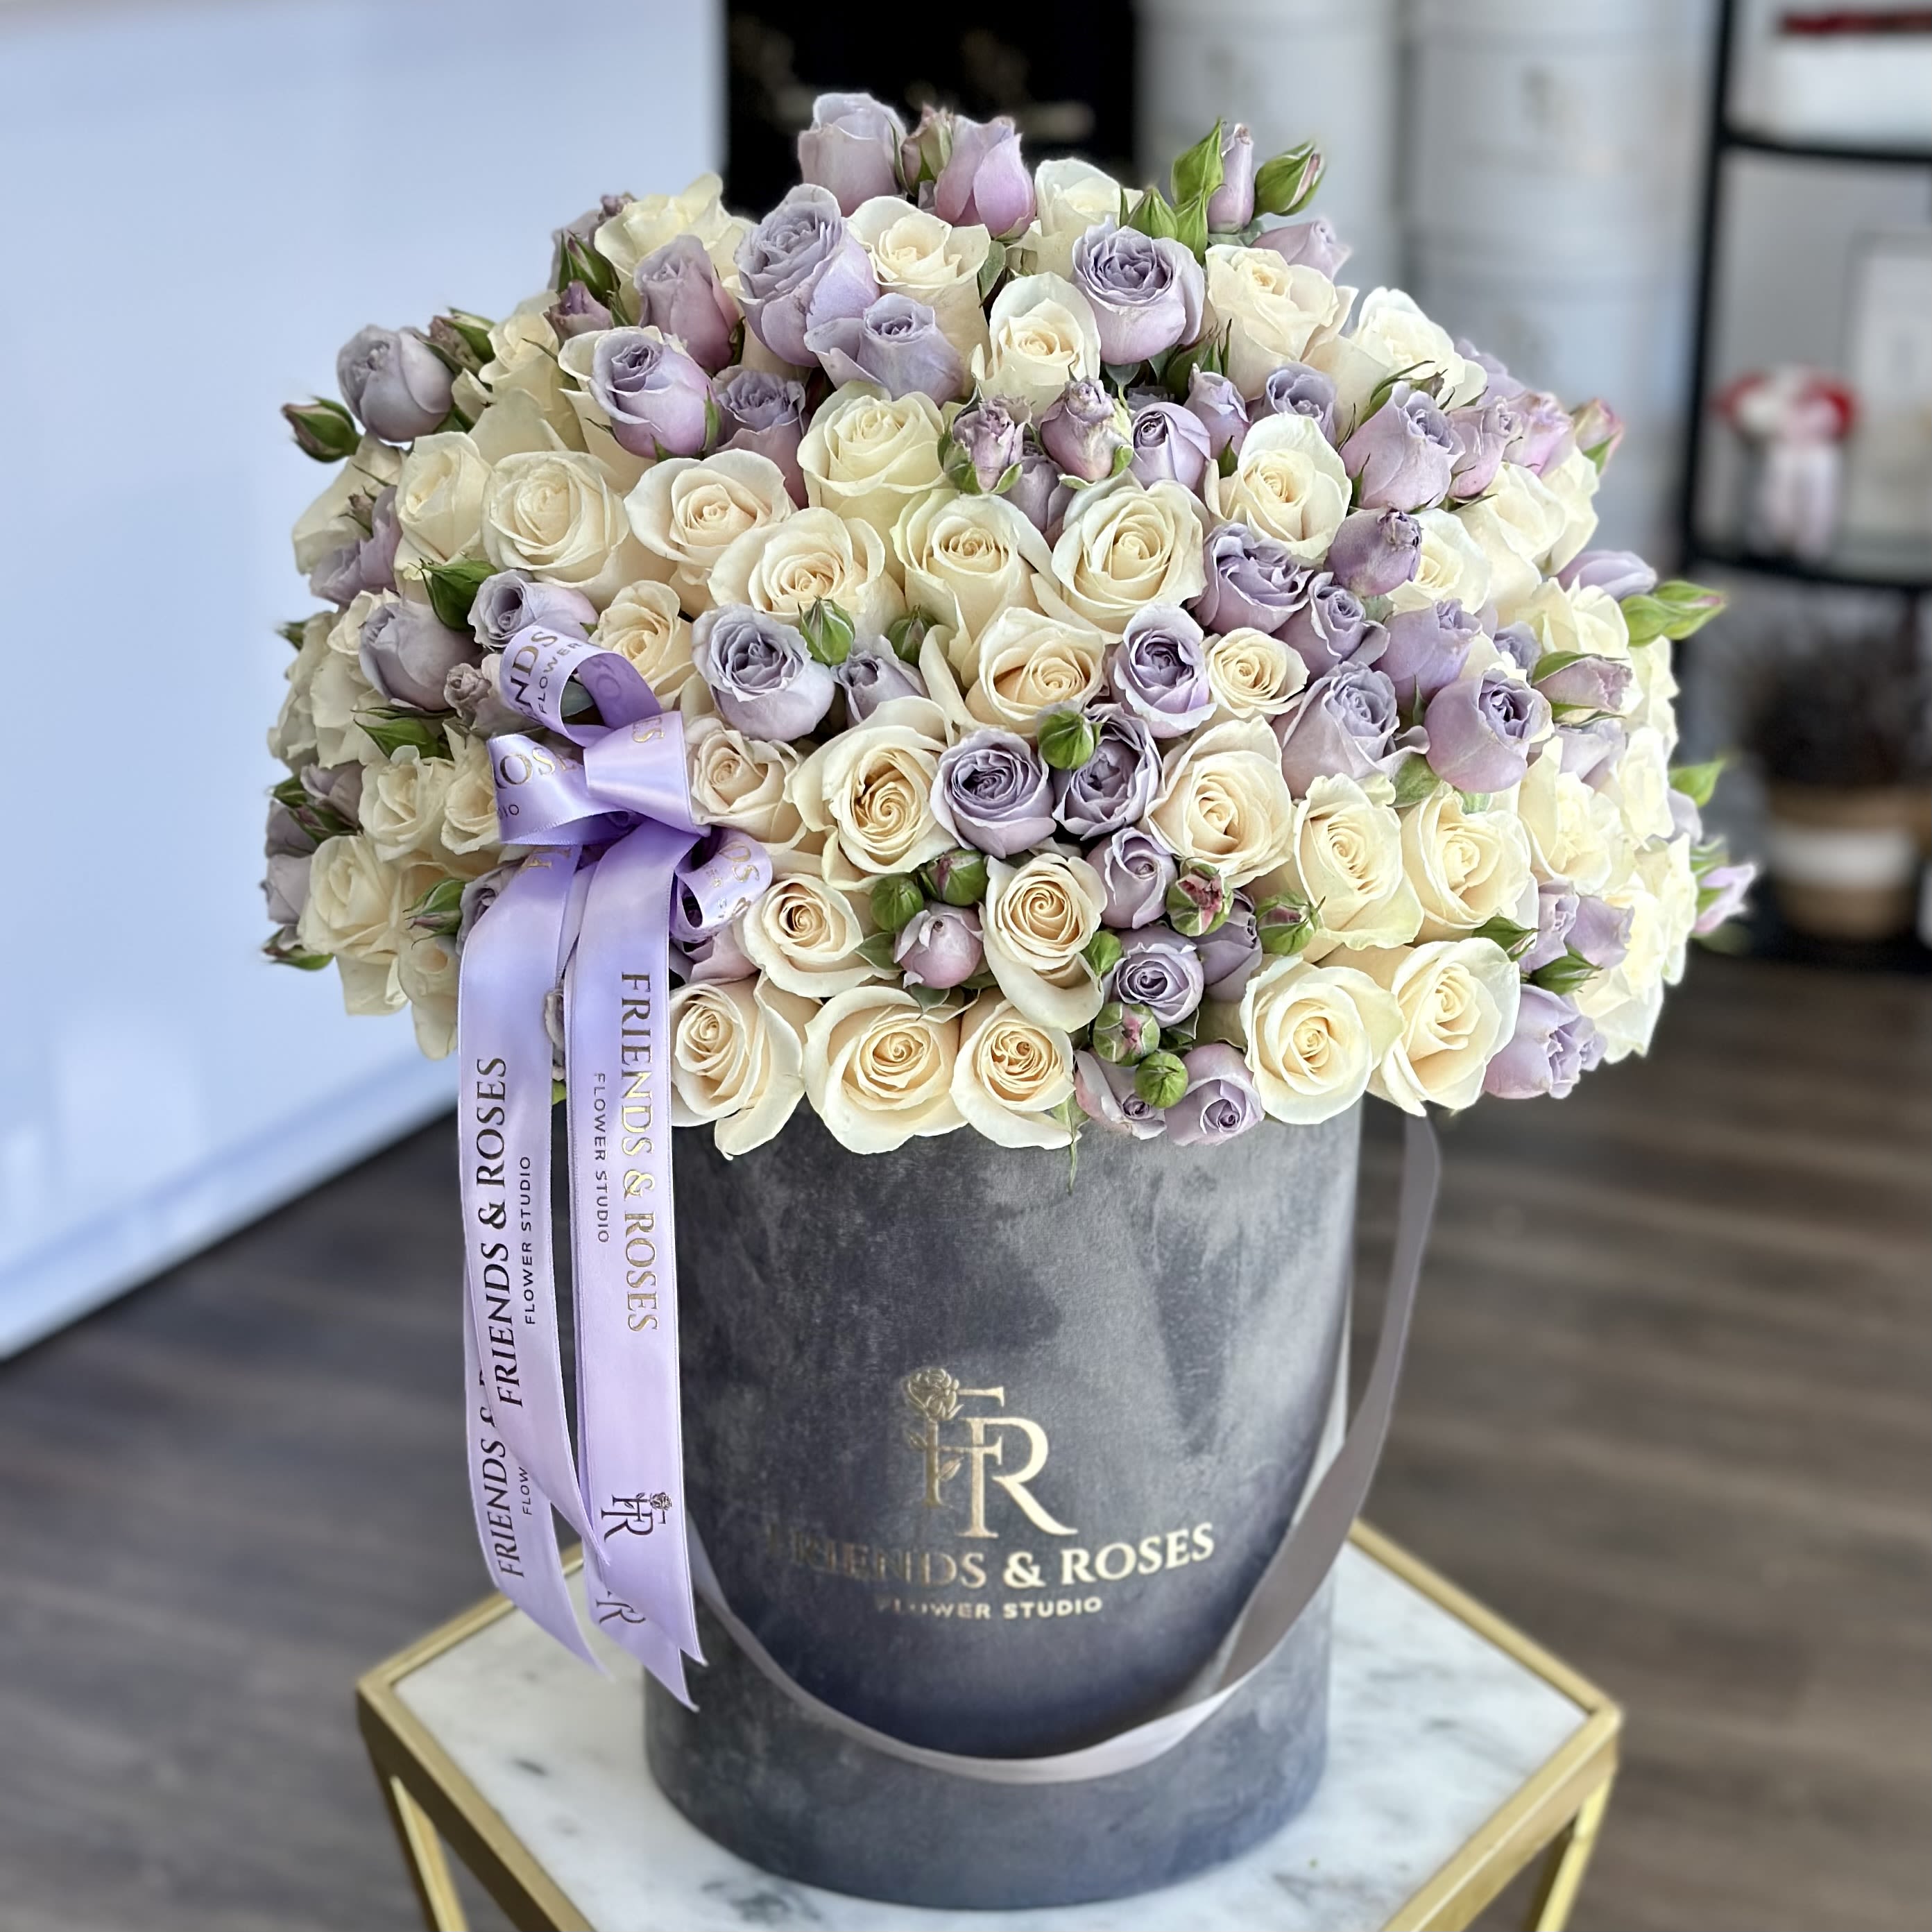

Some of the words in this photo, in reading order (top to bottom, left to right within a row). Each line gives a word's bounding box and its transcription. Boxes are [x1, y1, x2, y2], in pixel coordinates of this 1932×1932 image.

[538, 642, 583, 715] FLOWER
[621, 971, 653, 1156] FRIENDS
[476, 1057, 506, 1187] ROSES
[594, 1072, 606, 1161] FLOWER
[477, 1201, 506, 1230] &
[520, 1156, 532, 1232] STUDIO
[595, 1171, 610, 1243] STUDIO
[623, 1170, 656, 1199] &
[520, 1242, 536, 1324] FLOWER
[624, 1212, 658, 1333] ROSES
[480, 1243, 523, 1408] FRIENDS
[481, 1438, 524, 1578] FRIENDS
[1002, 1552, 1046, 1588] &
[1061, 1523, 1215, 1584] ROSES
[1003, 1597, 1102, 1619] STUDIO
